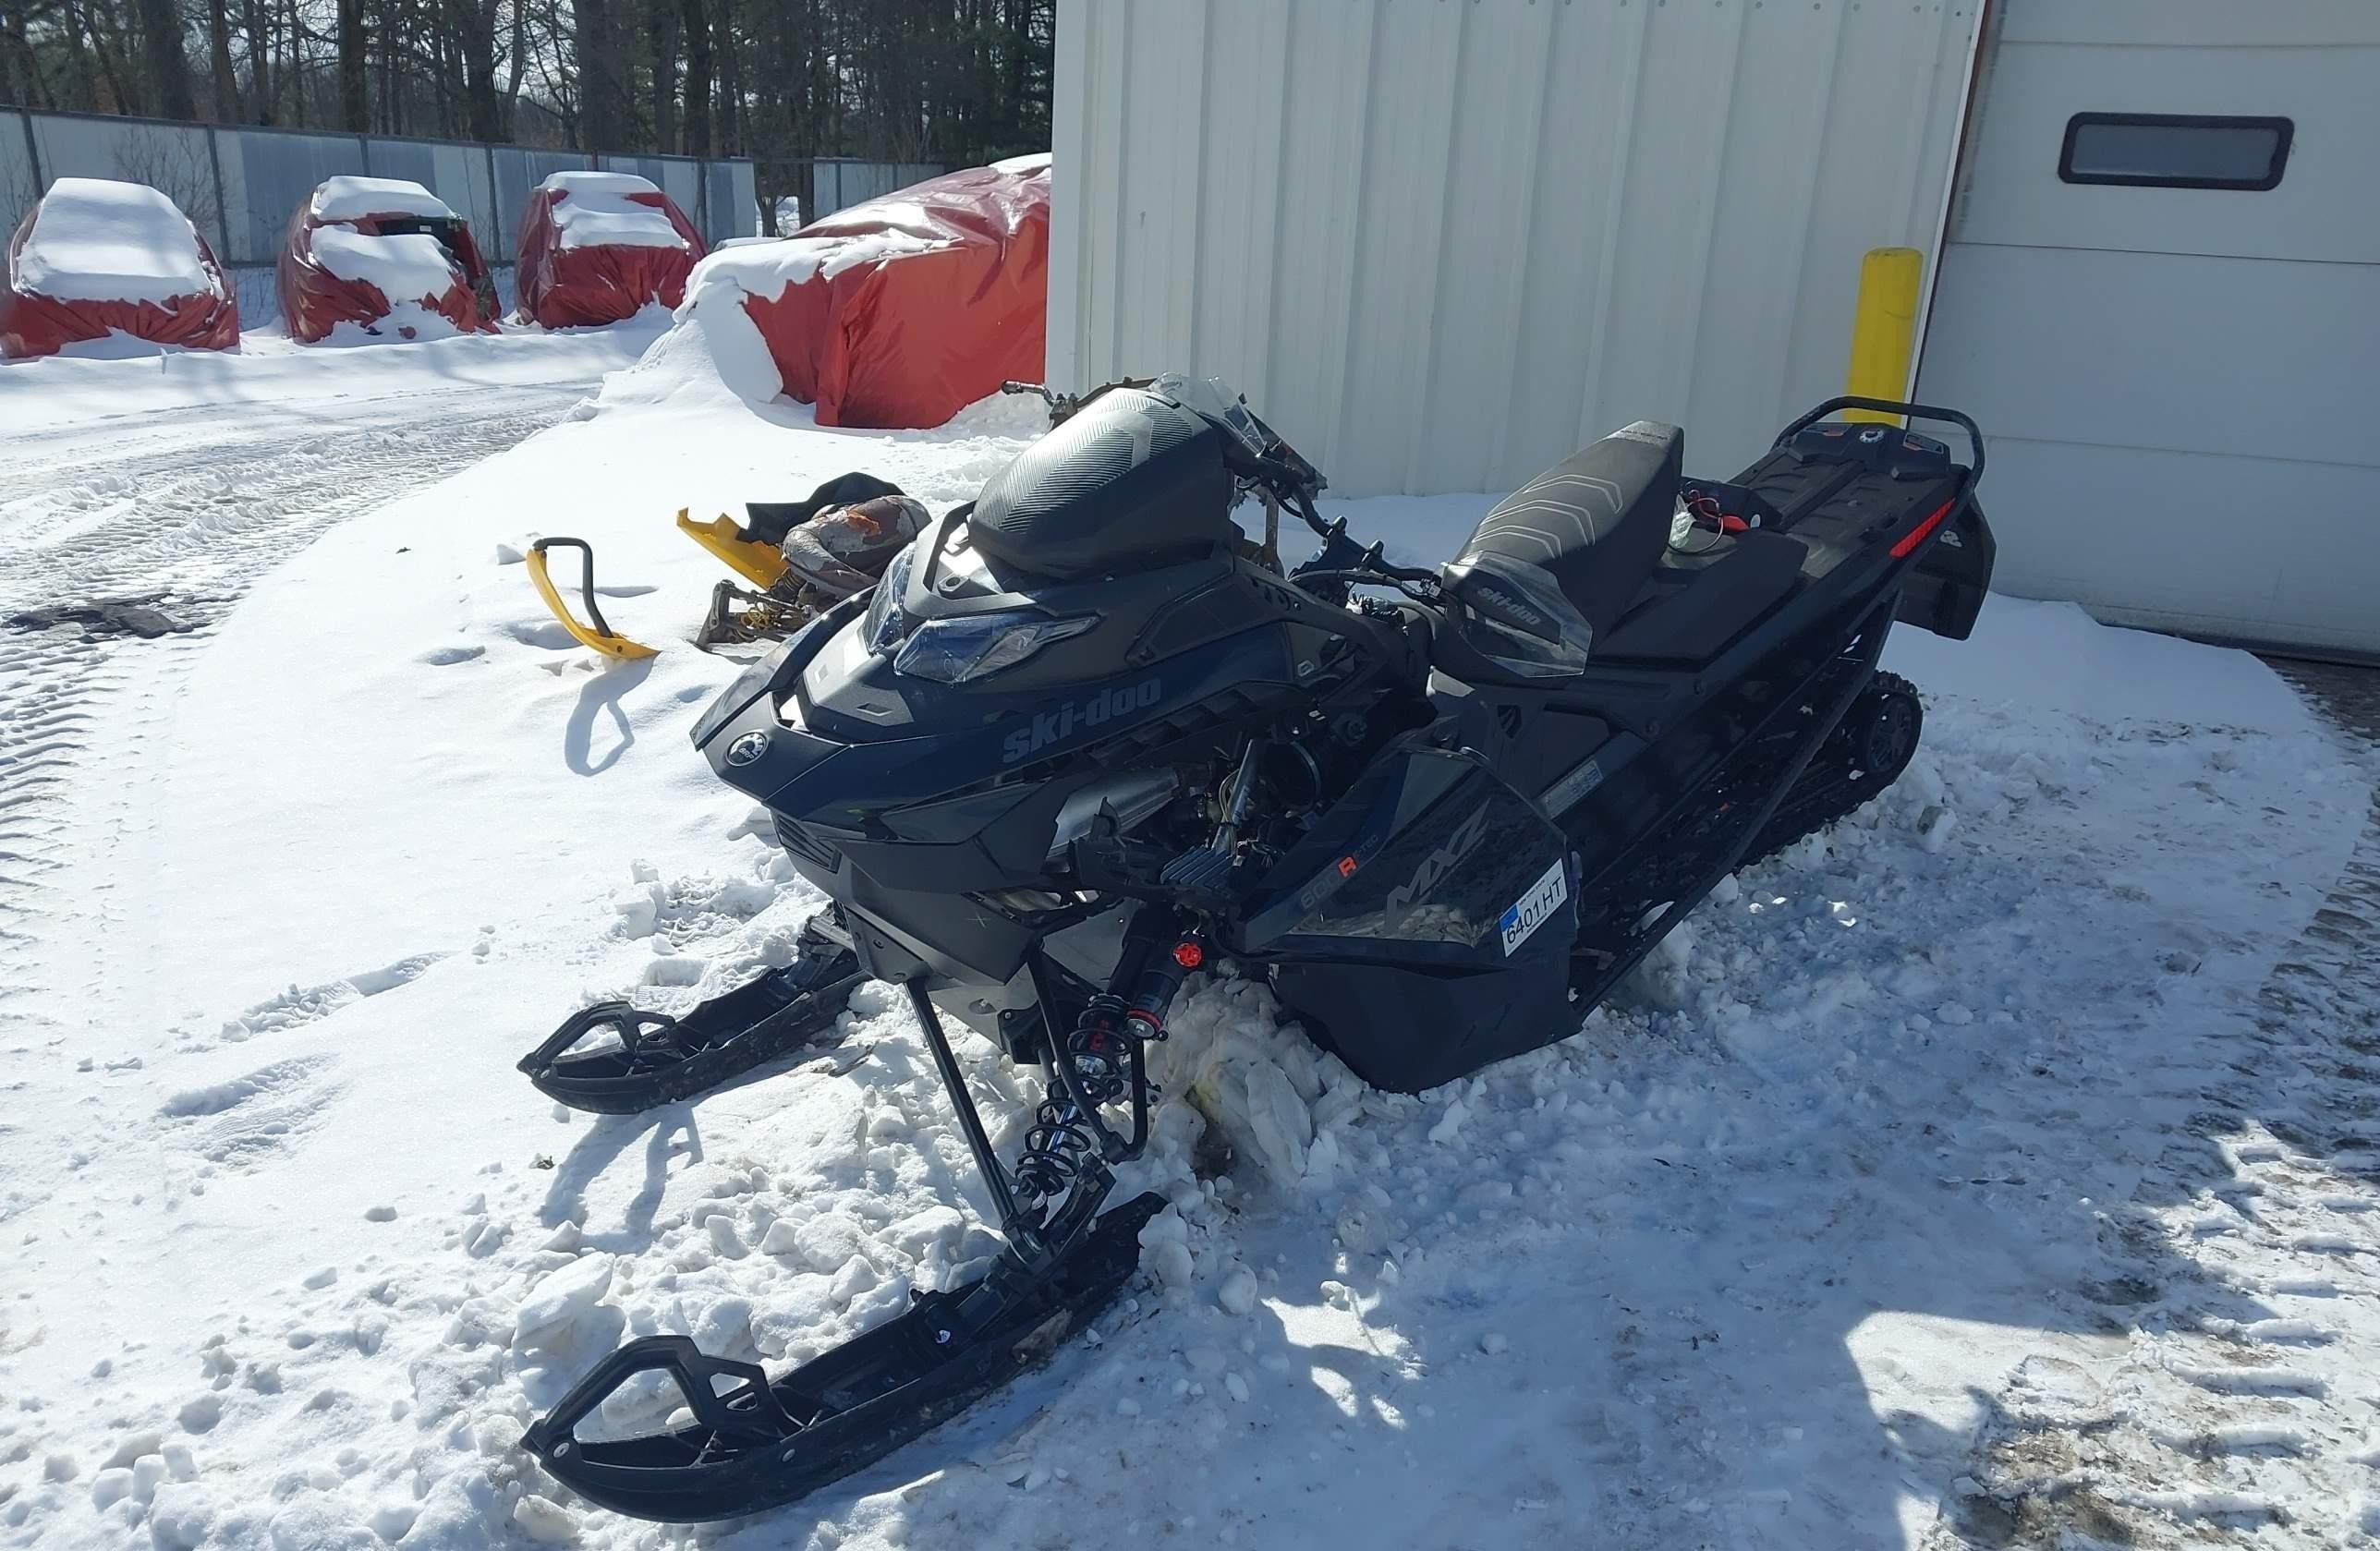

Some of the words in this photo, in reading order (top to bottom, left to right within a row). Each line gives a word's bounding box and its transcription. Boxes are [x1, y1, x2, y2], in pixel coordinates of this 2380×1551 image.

[738, 747, 755, 759] BRP
[1506, 899, 1540, 944] 6401
[1542, 876, 1561, 911] HT
